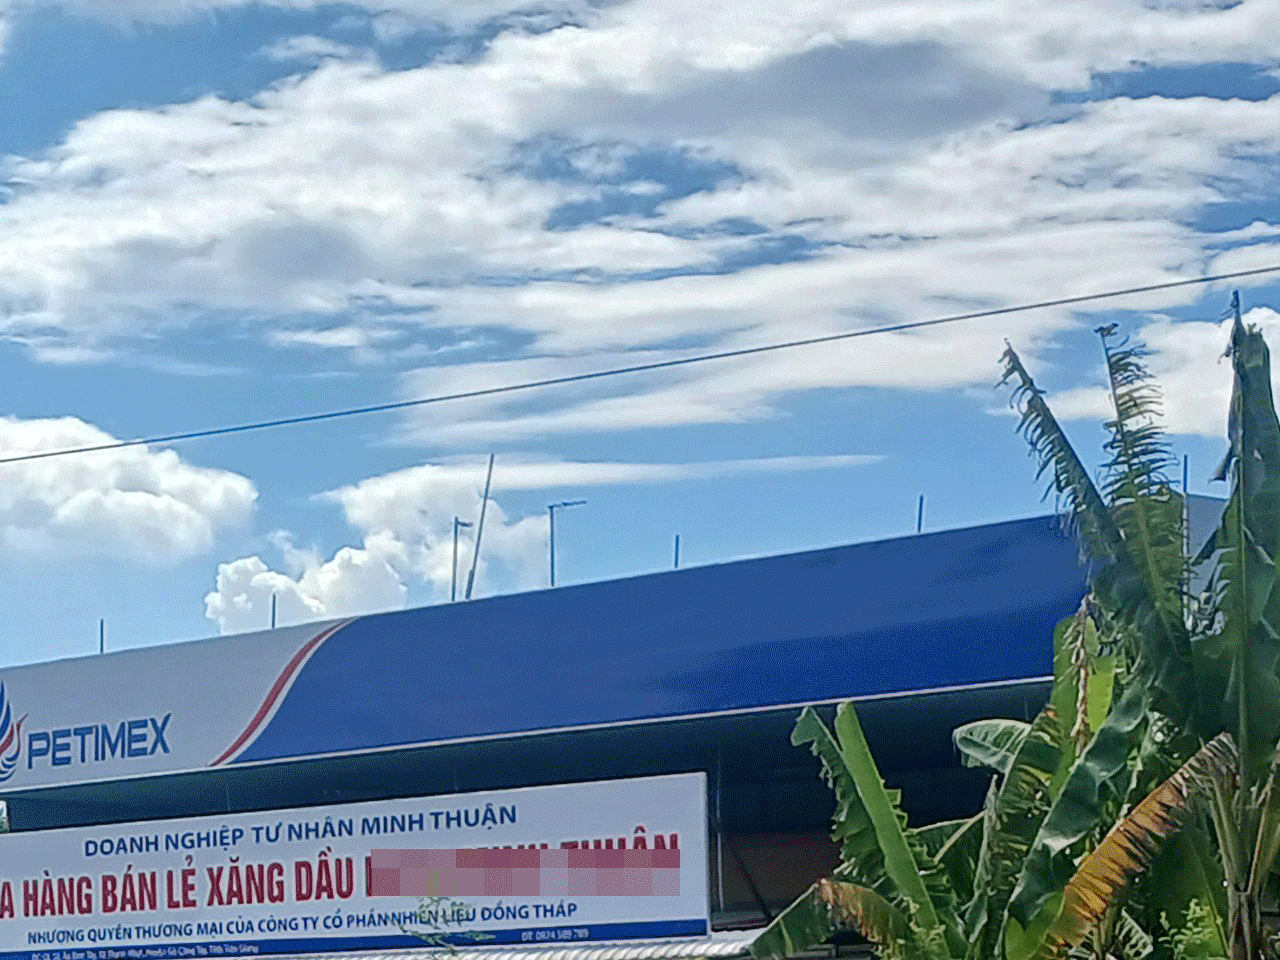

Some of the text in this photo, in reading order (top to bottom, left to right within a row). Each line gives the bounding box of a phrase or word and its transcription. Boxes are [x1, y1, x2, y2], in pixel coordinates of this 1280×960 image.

[27, 712, 172, 770] PETIMEX
[84, 803, 517, 857] DOANH NGHIỆP TƯ NHÂN MINH THUẬN
[23, 870, 93, 917] HÀNG
[101, 864, 158, 914] BÁN
[166, 855, 197, 909] LẺ
[206, 855, 285, 907] XĂNG
[294, 846, 354, 902] DẦU
[134, 922, 193, 939] THƯƠNG
[196, 921, 223, 939] MẠI
[226, 915, 255, 935] CỦA
[257, 914, 299, 932] CÔNG
[301, 916, 319, 930] TY
[532, 898, 578, 919] THÁP
